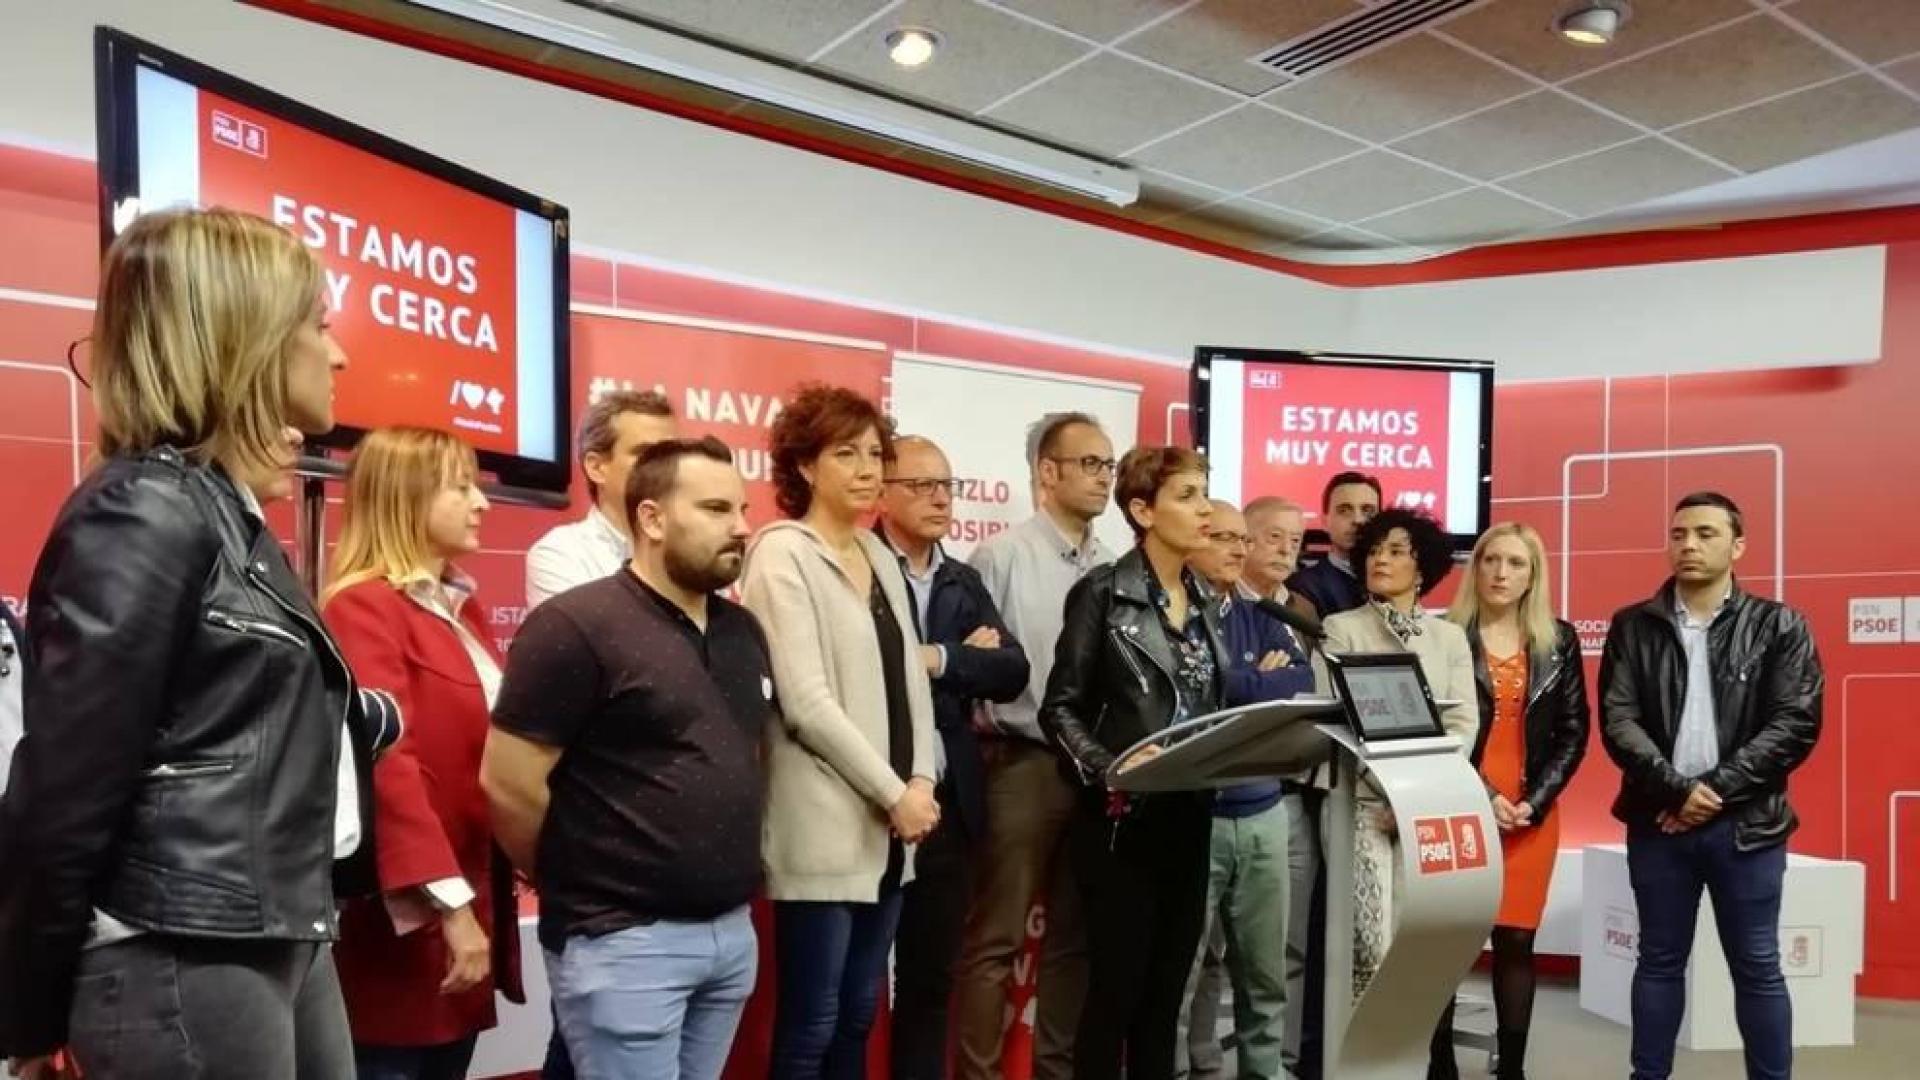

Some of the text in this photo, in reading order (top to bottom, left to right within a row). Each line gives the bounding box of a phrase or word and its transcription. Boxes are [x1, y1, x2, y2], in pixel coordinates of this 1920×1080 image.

[272, 194, 478, 294] ESTAMOS
[370, 284, 498, 352] CERCA
[1282, 405, 1419, 436] ESTAMOS
[1265, 437, 1434, 469] MUY CERCA
[962, 479, 1010, 504] ZLO
[1853, 618, 1899, 633] PSOE
